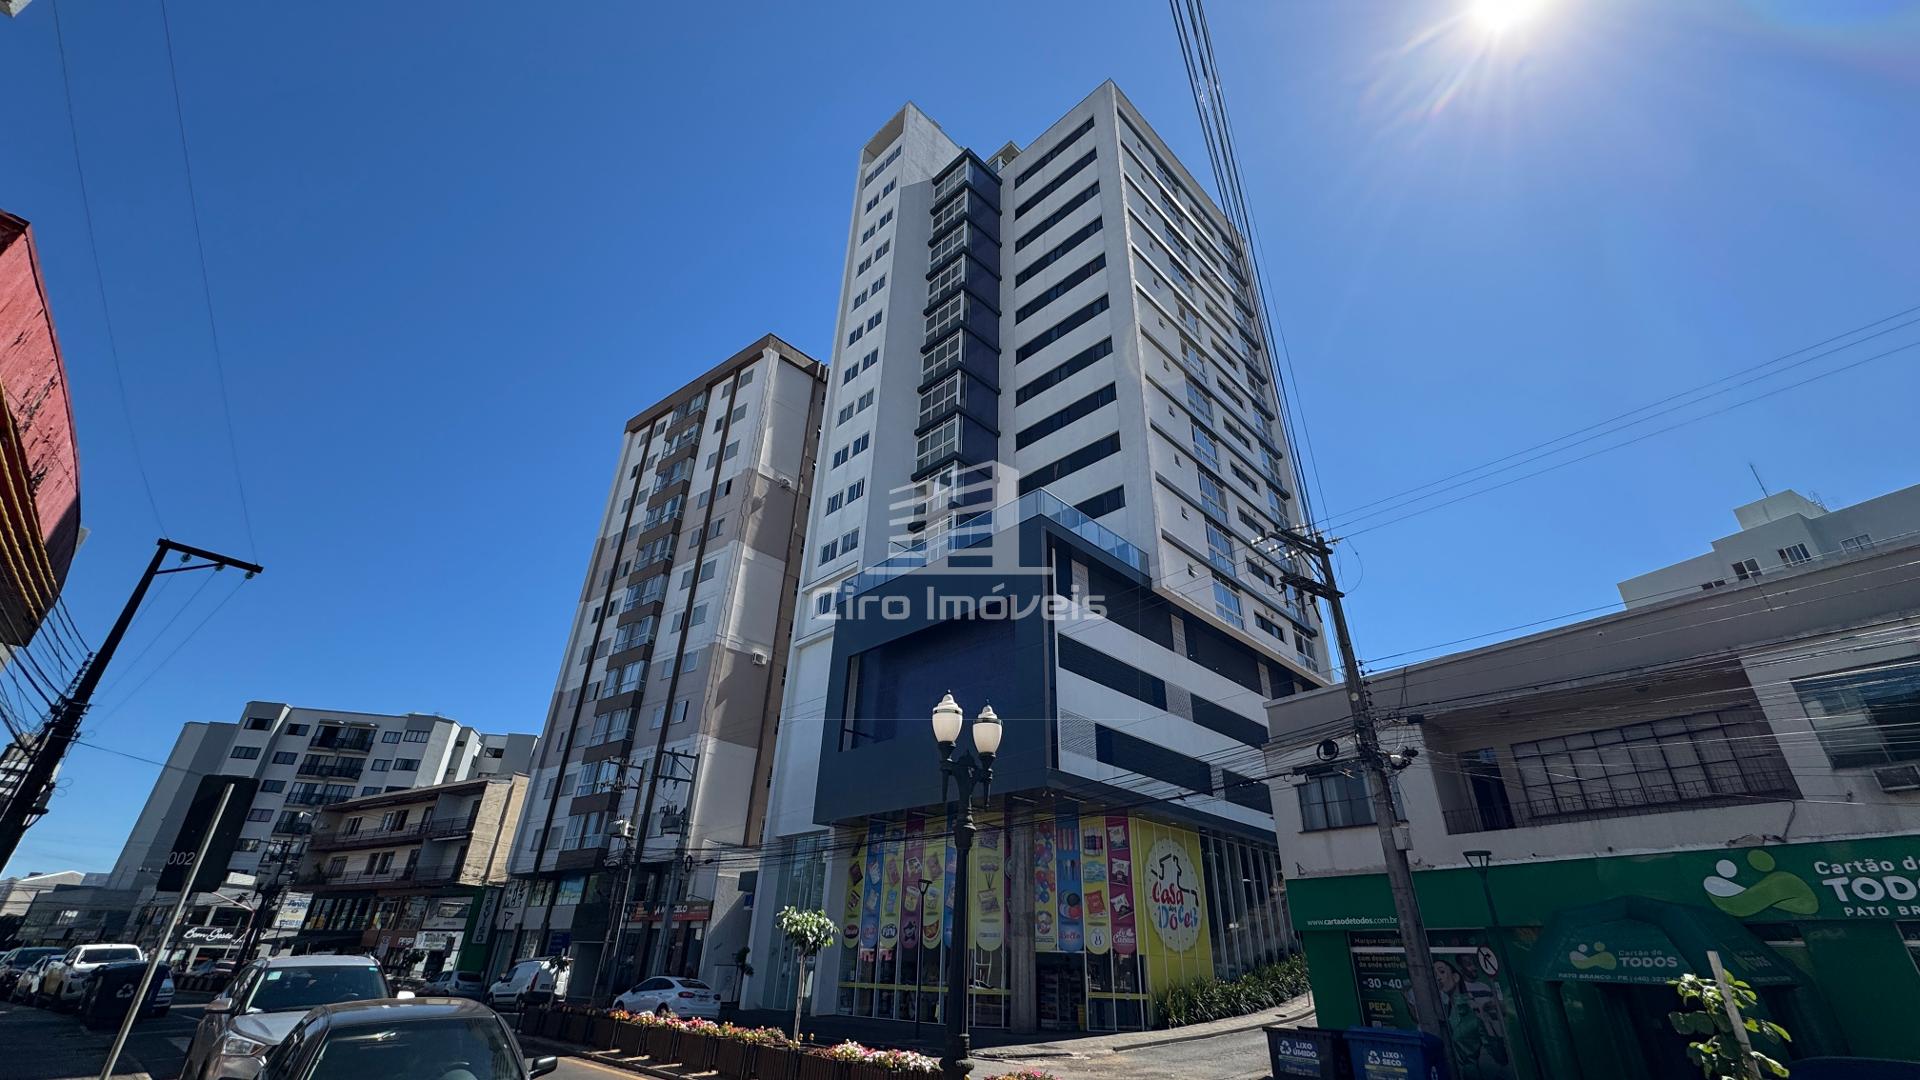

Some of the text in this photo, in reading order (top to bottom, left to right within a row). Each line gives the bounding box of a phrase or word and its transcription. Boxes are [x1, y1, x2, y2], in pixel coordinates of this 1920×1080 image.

[167, 851, 196, 866] 002
[1813, 855, 1920, 875] Cartão d
[1152, 881, 1184, 905] Casa
[1822, 875, 1920, 902] TOD
[1844, 906, 1890, 917] PATO
[1307, 916, 1398, 927] www.cartaodetodos.com.br
[1618, 956, 1679, 969] TODOS
[1295, 1041, 1313, 1050] LIXO
[1382, 1051, 1399, 1060] LIXO
[1382, 1058, 1402, 1067] SECO
